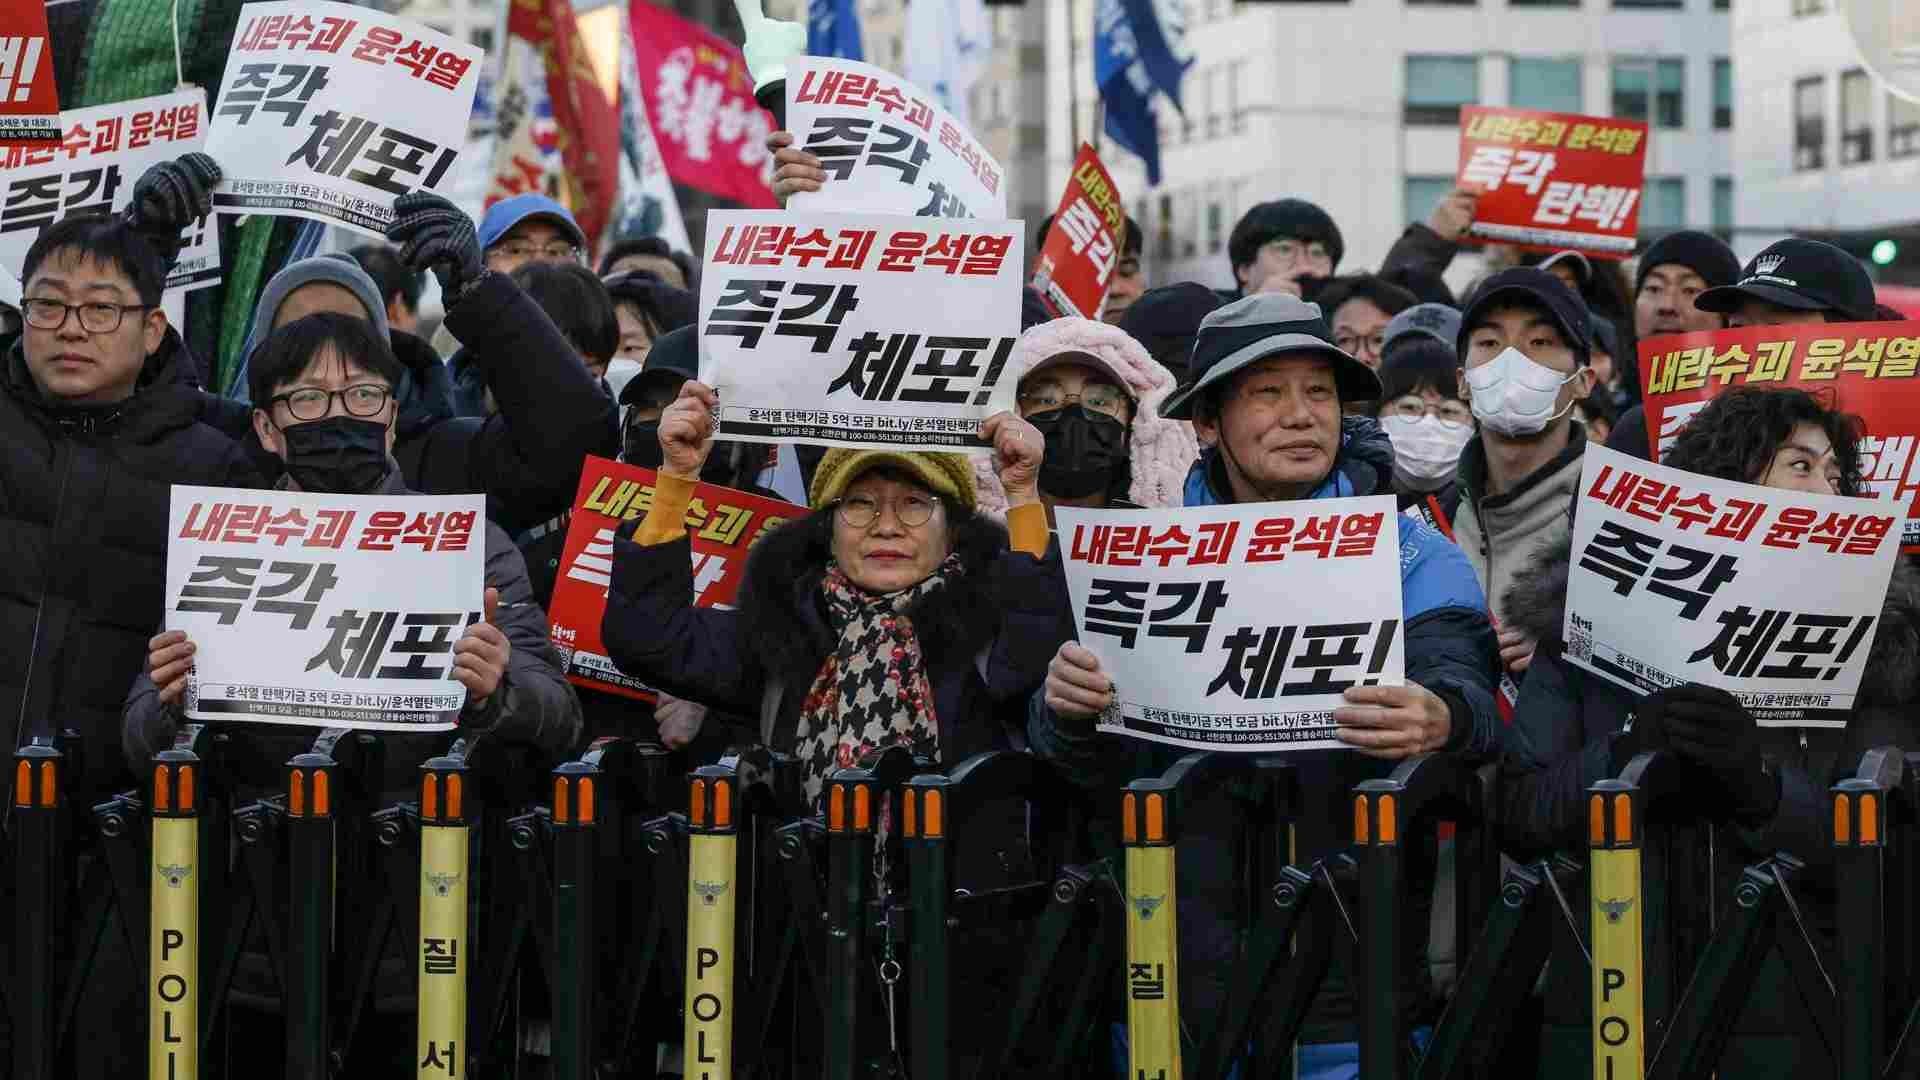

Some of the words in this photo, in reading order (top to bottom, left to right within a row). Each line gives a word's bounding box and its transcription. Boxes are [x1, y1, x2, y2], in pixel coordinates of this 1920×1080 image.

[236, 14, 358, 55] 내란수괴
[351, 25, 472, 90] 윤석열
[128, 103, 200, 149] 윤석열
[218, 63, 334, 126] 즉각
[284, 110, 458, 195] 체포!
[796, 70, 935, 133] 내란수괴
[938, 121, 1001, 196] 윤석열
[803, 117, 930, 185] 즉각
[1466, 114, 1567, 145] 내란수괴
[1567, 124, 1643, 154] 윤석열
[0, 165, 123, 233] 즉각
[1462, 147, 1557, 195] 즉각
[1533, 182, 1639, 230] 탄핵!
[711, 224, 877, 272] 내란수괴
[878, 231, 1014, 276] 윤석열
[1058, 198, 1116, 286] 즉각
[704, 279, 860, 354] 즉각
[827, 331, 1016, 407] 체포!
[1647, 341, 1796, 396] 내란수괴
[1799, 335, 1920, 384] 윤석열
[749, 409, 782, 422] 윤석열
[785, 410, 829, 425] 탄핵기금
[832, 414, 849, 428] 5억
[853, 415, 873, 428] 모금
[878, 416, 984, 432] bit.ly/윤석열탄핵기
[179, 503, 356, 549] 내란수괴
[357, 511, 477, 552] 윤석열
[1071, 520, 1240, 567] 내란수괴
[1245, 512, 1384, 563] 윤석열
[1587, 464, 1768, 542] 내란수괴
[1762, 507, 1896, 555] 윤석열
[176, 556, 338, 630] 즉각
[1579, 520, 1738, 620] 즉각
[1085, 578, 1229, 654] 즉각
[1686, 605, 1876, 680] 체포!
[1206, 619, 1399, 700] 체포!
[225, 686, 258, 699] 윤석열
[263, 688, 305, 702] 탄핵기금
[309, 692, 327, 703] 5억
[331, 694, 352, 705] 모금
[1143, 708, 1169, 722] 윤석열
[1172, 712, 1211, 728] 탄핵기금
[1215, 715, 1232, 728] 5억
[1236, 716, 1258, 728] 모금
[1262, 712, 1335, 728] bit.ly/윤석열
[692, 947, 721, 1080] POL
